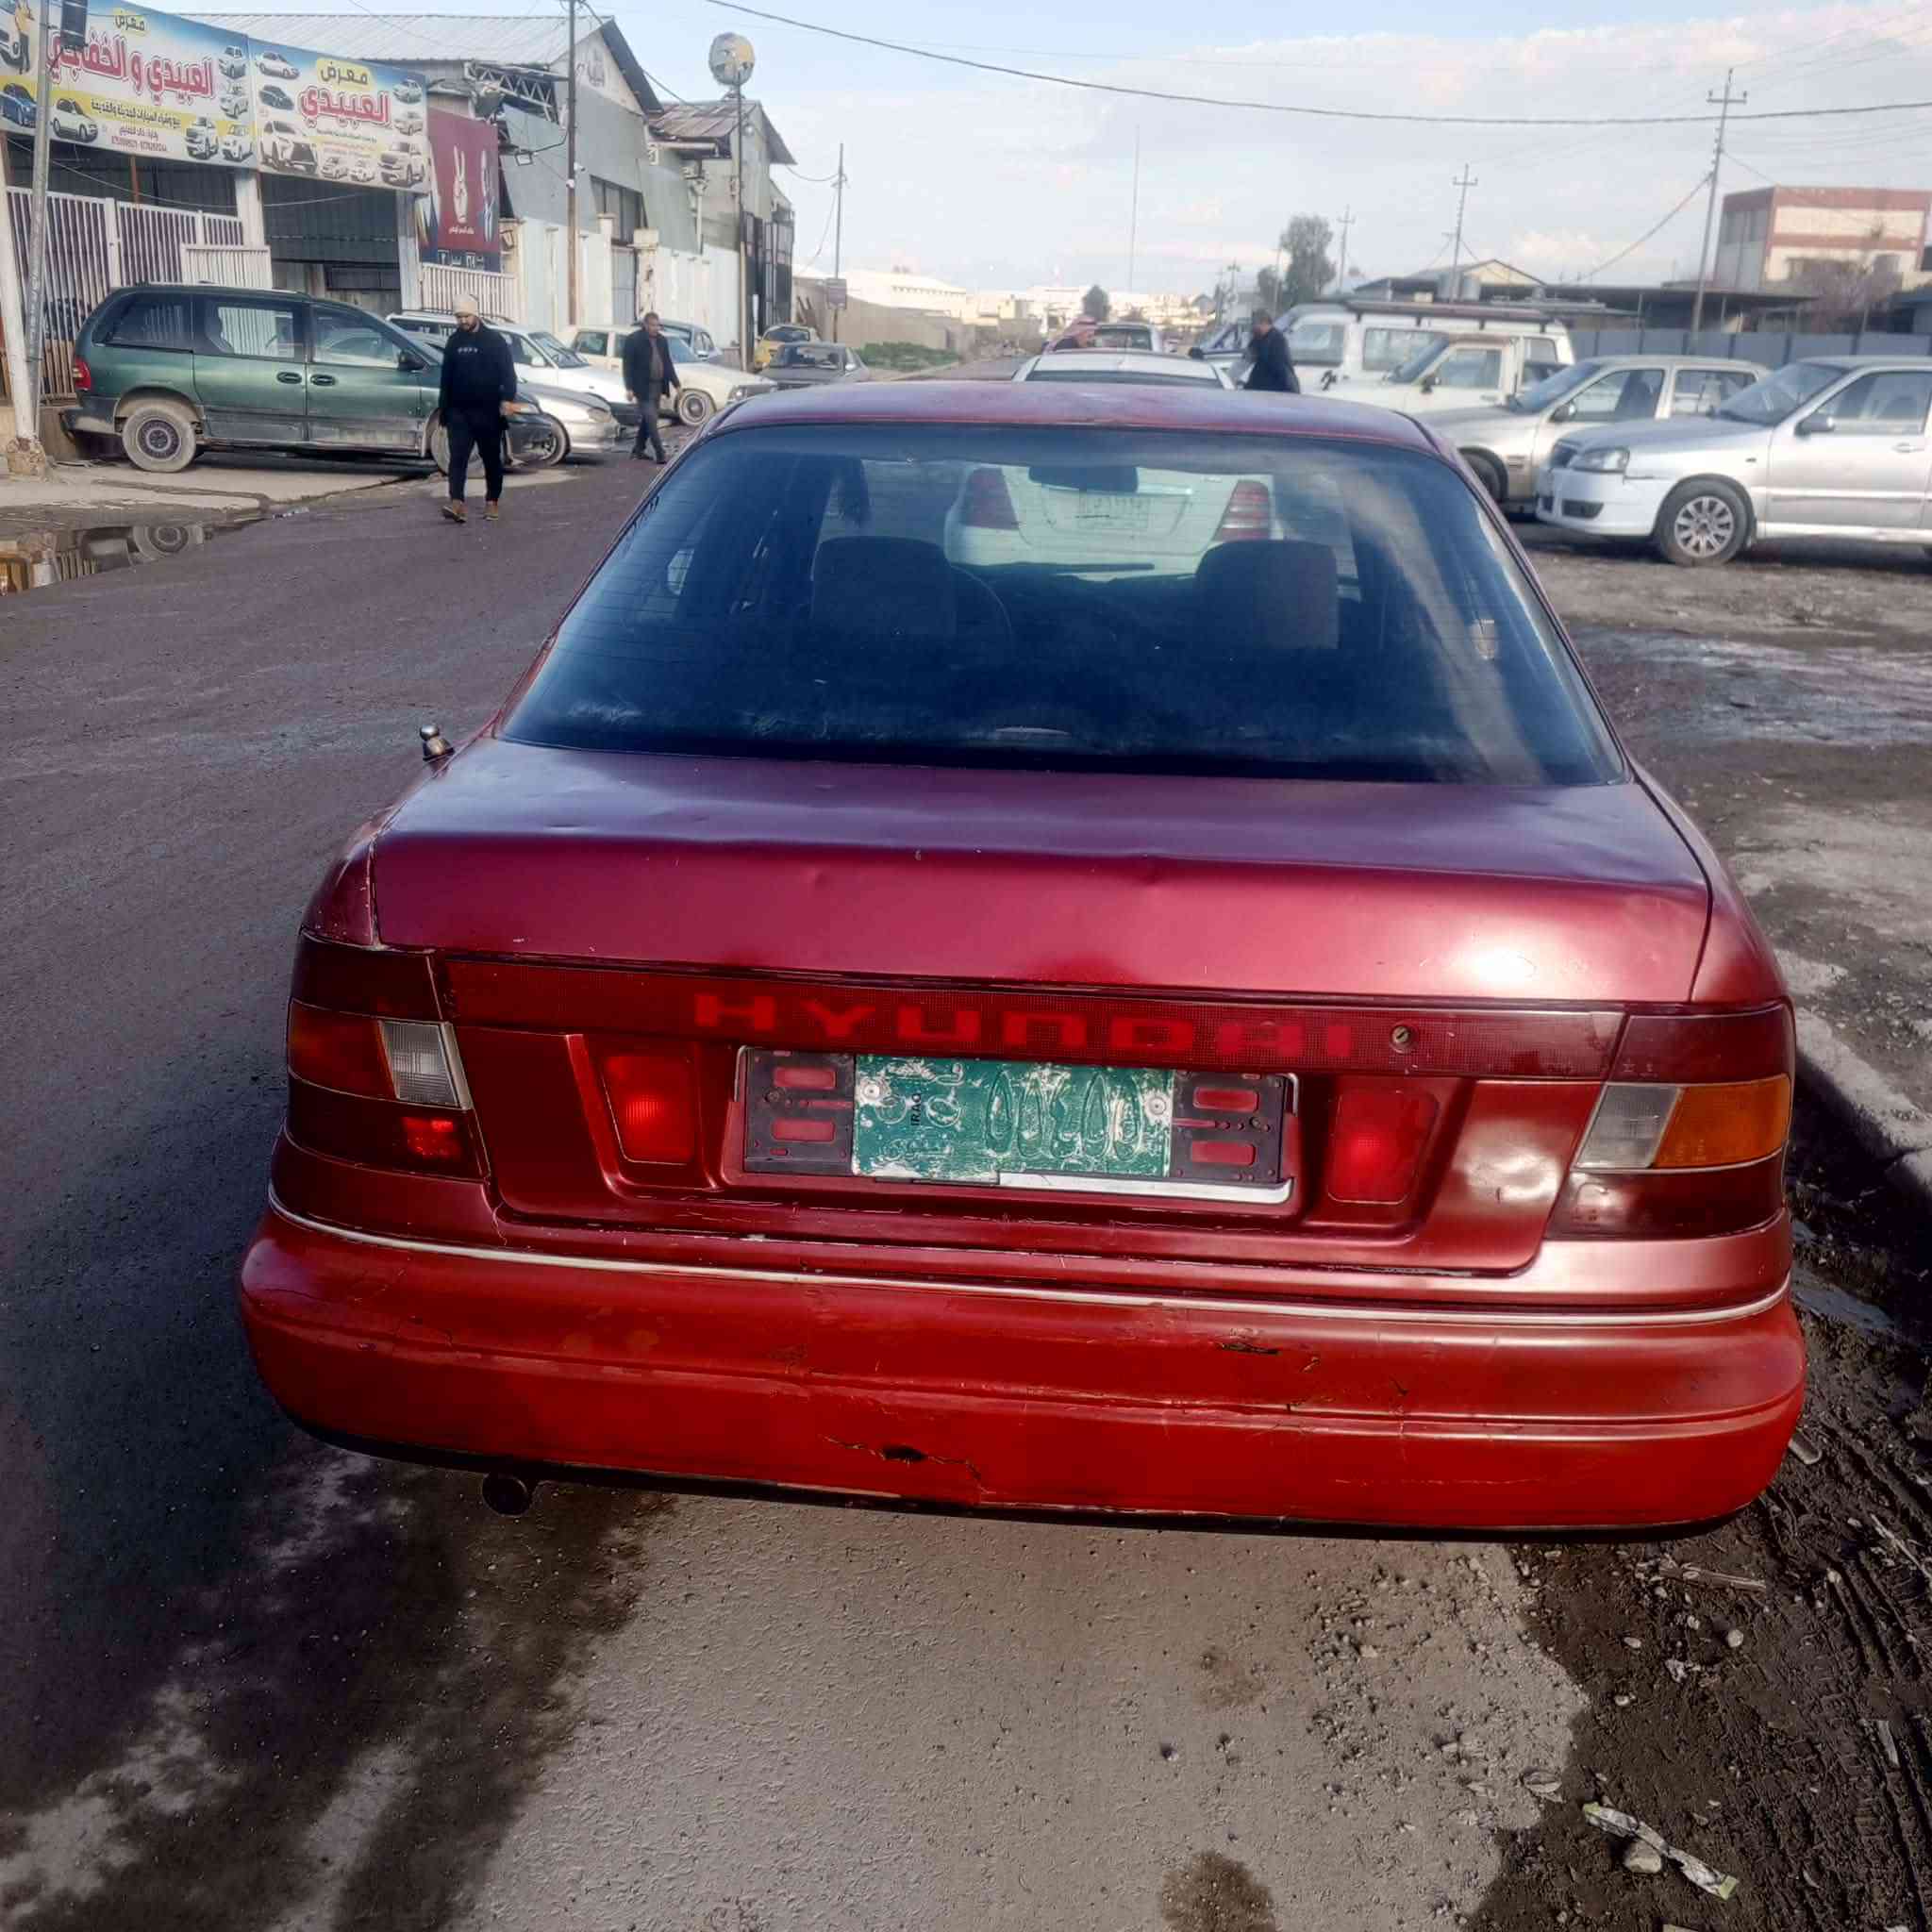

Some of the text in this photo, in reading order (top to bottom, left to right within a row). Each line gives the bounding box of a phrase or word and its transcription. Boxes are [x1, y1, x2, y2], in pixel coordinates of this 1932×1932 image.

[129, 51, 145, 96] و
[144, 56, 214, 106] العبيدي
[320, 61, 369, 86] معرض
[299, 86, 391, 128] العبيدي
[694, 993, 1351, 1058] HYUNDAI
[910, 1091, 923, 1126] IRAQ
